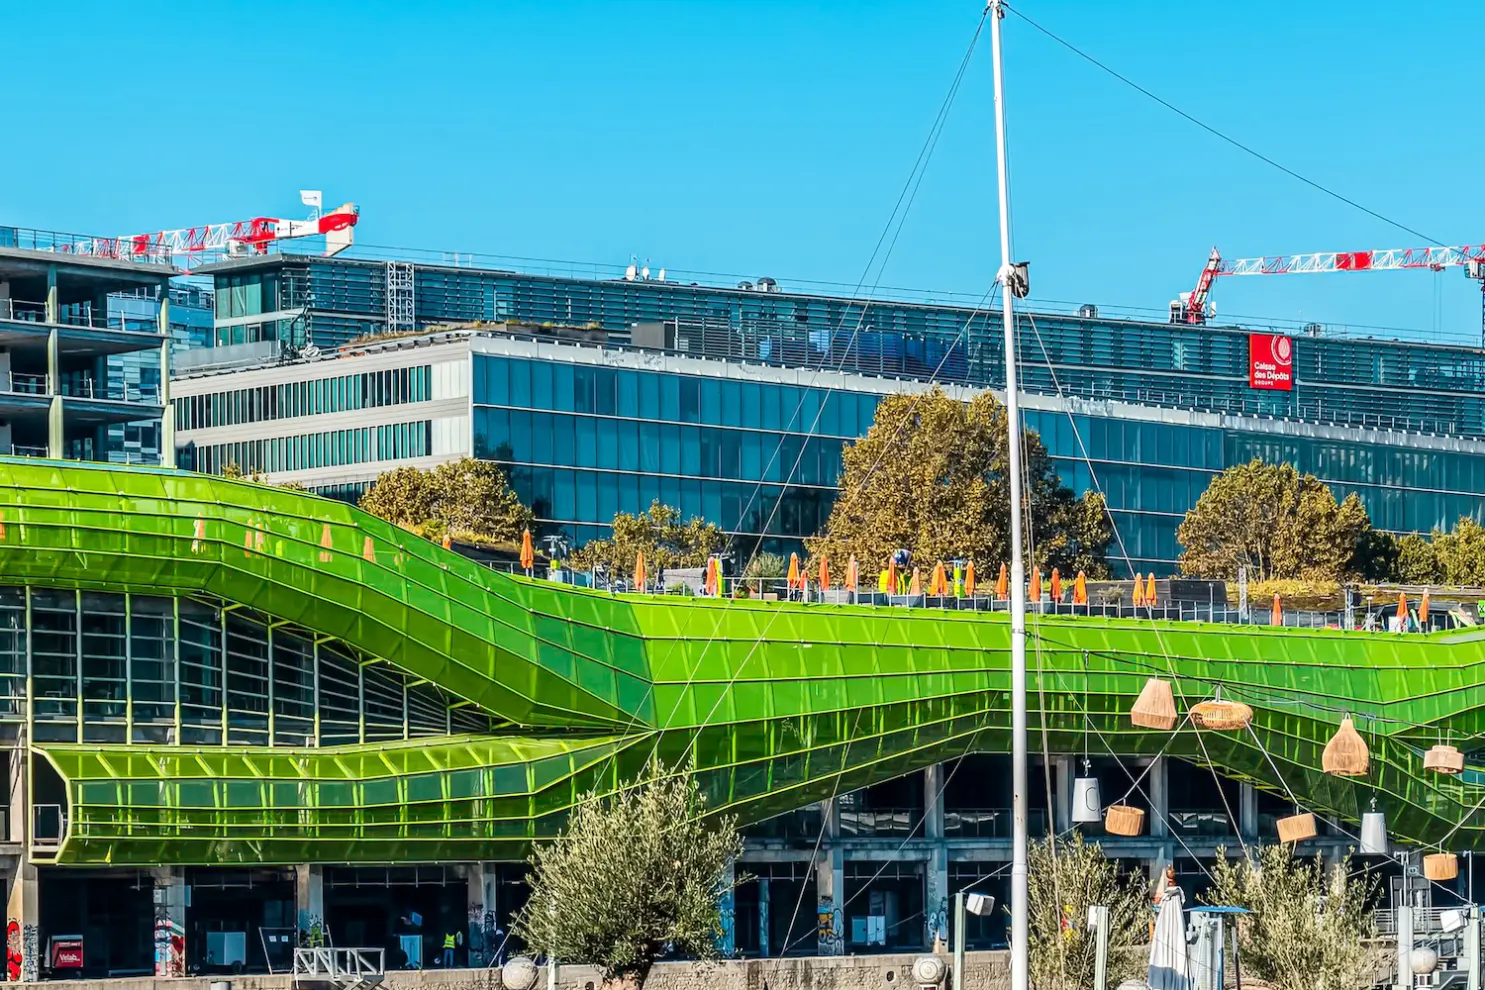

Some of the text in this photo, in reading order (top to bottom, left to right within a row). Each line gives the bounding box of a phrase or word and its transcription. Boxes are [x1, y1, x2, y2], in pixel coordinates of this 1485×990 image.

[1254, 361, 1276, 371] Caisse
[1254, 370, 1290, 381] des Dépôts
